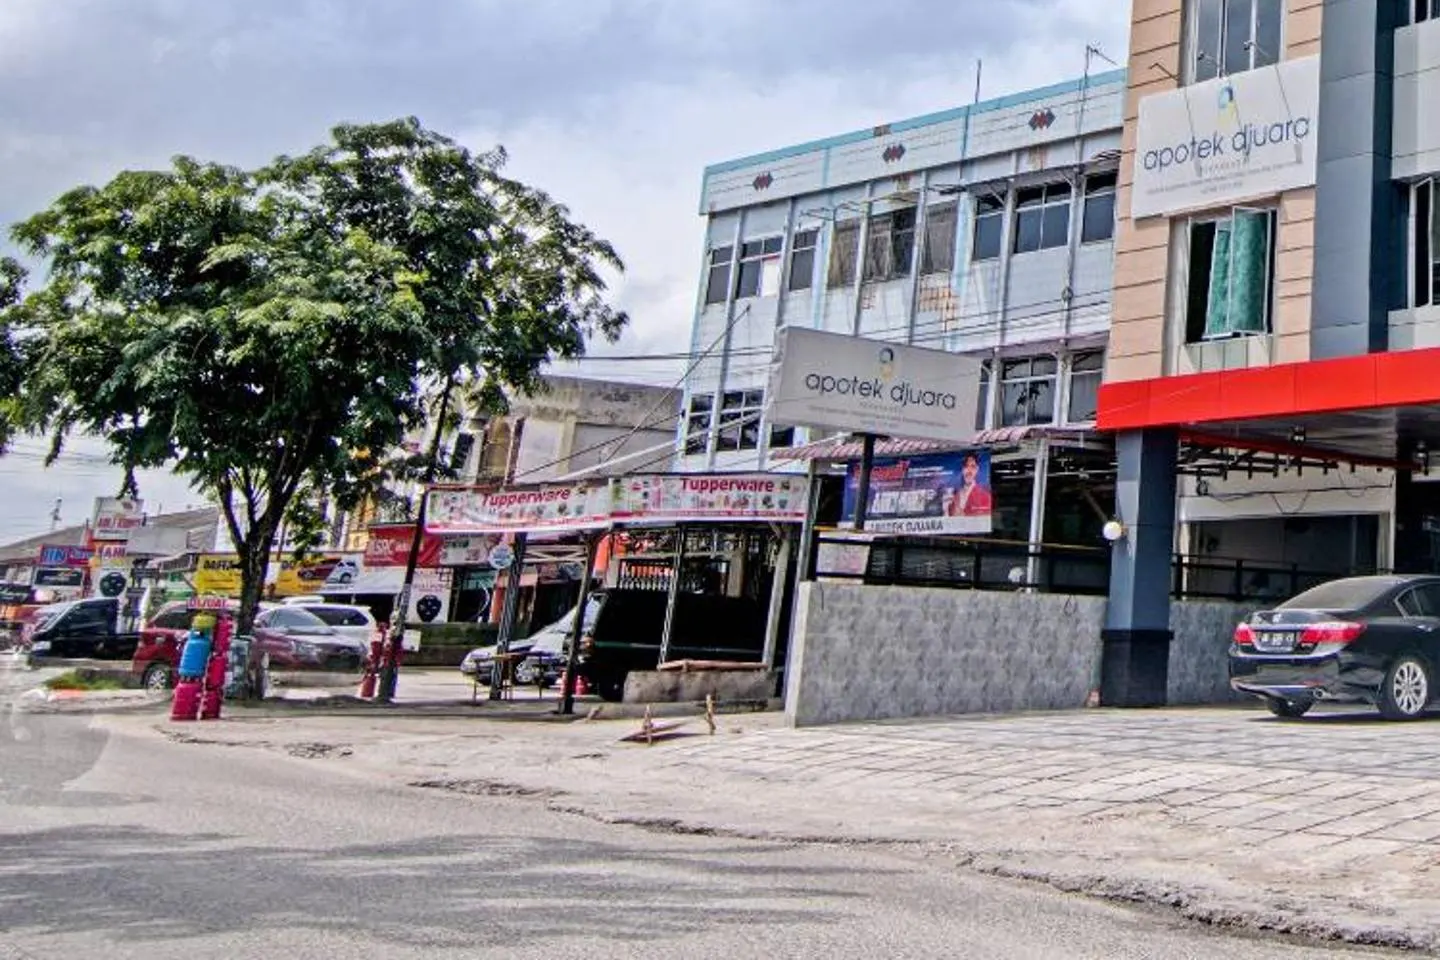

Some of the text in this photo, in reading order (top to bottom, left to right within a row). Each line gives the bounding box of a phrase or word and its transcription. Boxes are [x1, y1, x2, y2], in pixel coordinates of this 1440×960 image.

[1143, 117, 1310, 172] apotek djuara
[804, 372, 957, 410] apotek djuara
[481, 488, 572, 508] Tupperware
[681, 478, 775, 494] Tupperware
